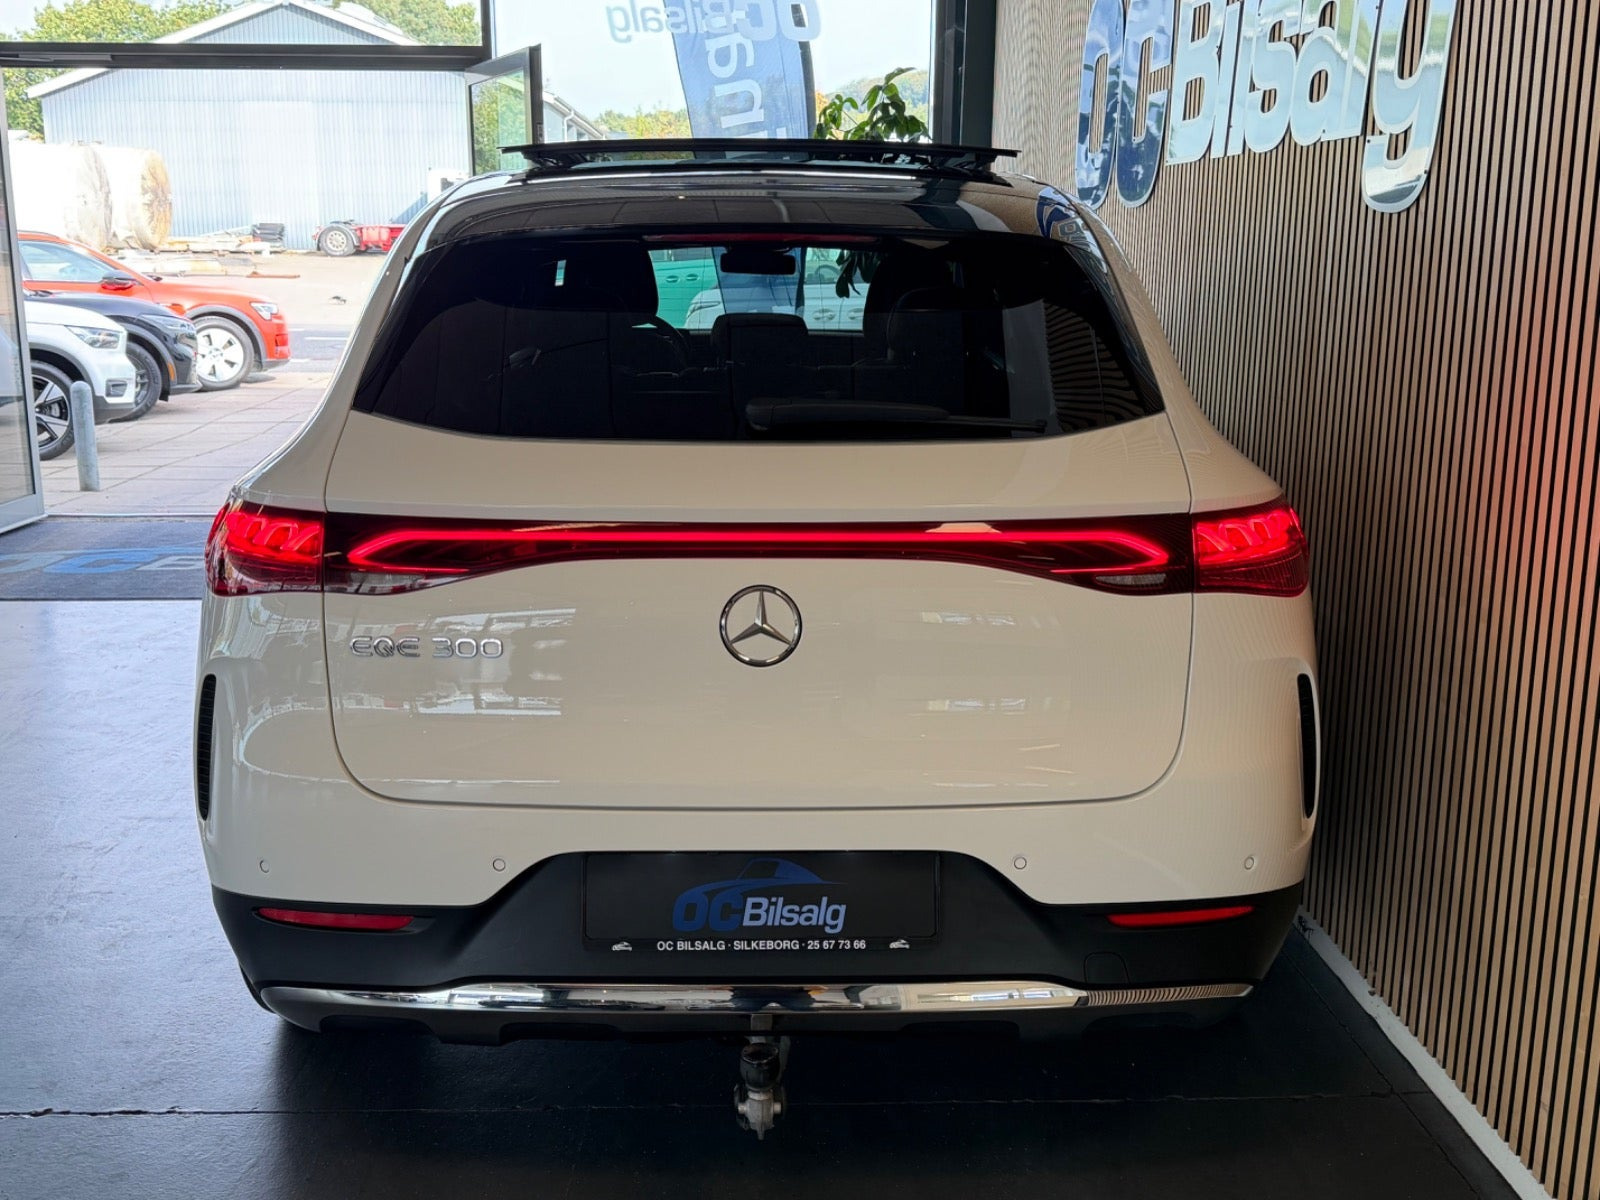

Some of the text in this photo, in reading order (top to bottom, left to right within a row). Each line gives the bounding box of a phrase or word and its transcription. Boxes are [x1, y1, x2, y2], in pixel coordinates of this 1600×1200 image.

[350, 635, 504, 659] EQE 300
[656, 939, 867, 951] OC BILSALG SILKEBORG 25 67 73 66
